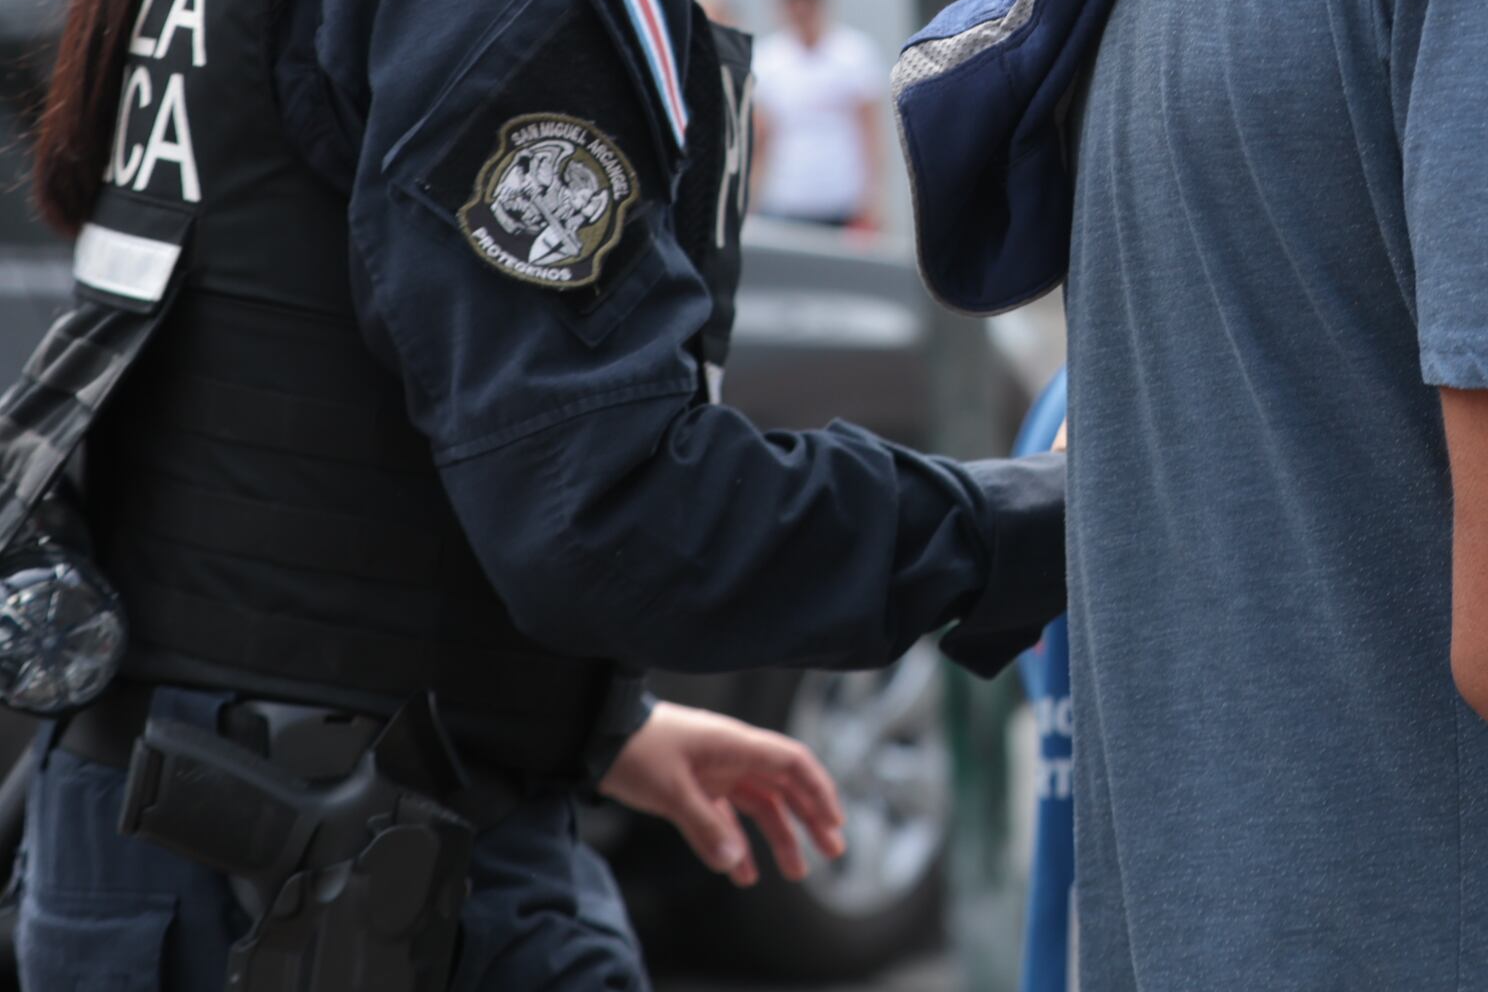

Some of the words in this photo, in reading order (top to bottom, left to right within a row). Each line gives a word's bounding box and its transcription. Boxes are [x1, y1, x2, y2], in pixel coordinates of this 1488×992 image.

[511, 123, 540, 146] SAN
[540, 121, 587, 146] MIGUEL
[471, 227, 572, 281] PROTEGENOS
